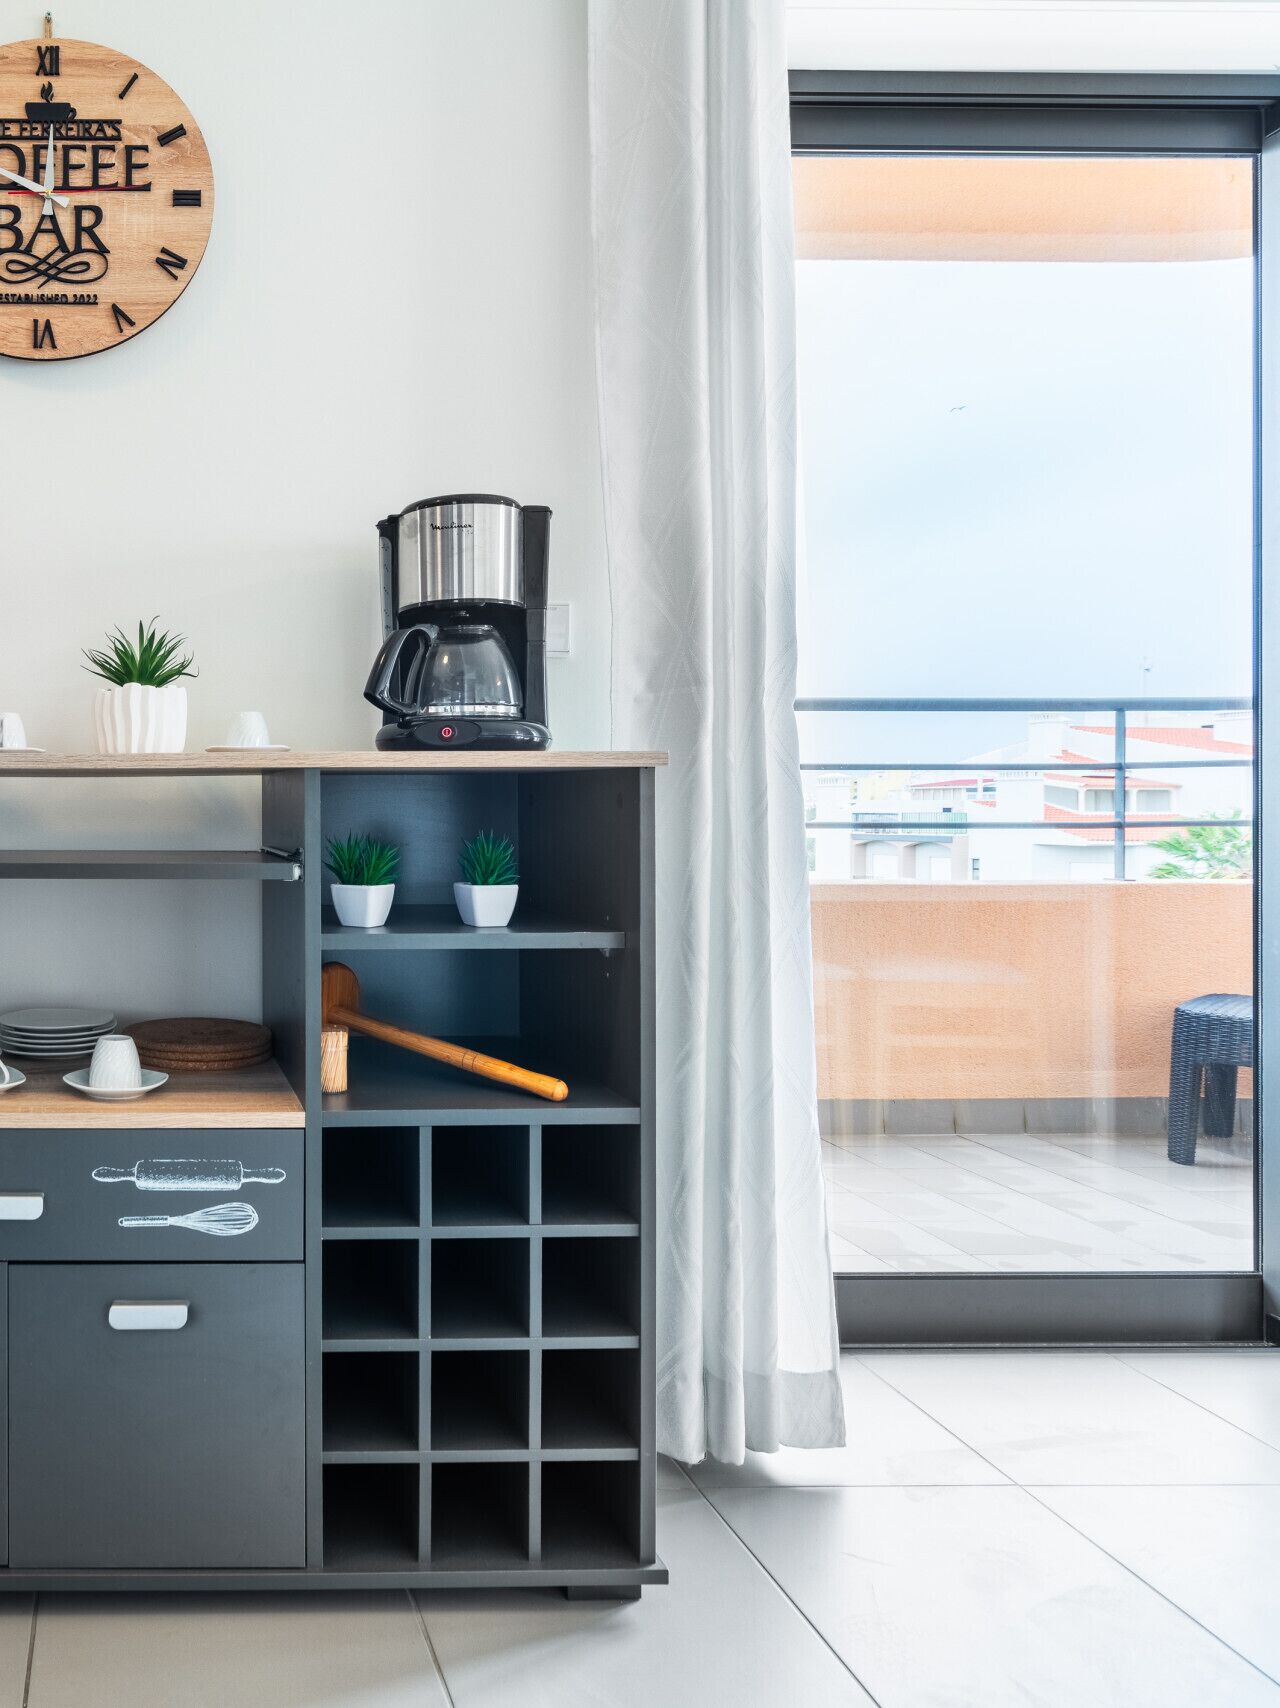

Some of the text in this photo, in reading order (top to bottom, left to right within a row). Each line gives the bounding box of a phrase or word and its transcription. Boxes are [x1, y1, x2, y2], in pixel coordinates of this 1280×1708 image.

[35, 45, 60, 76] XII
[20, 120, 122, 138] FERREIRA'S
[72, 293, 98, 304] 2022
